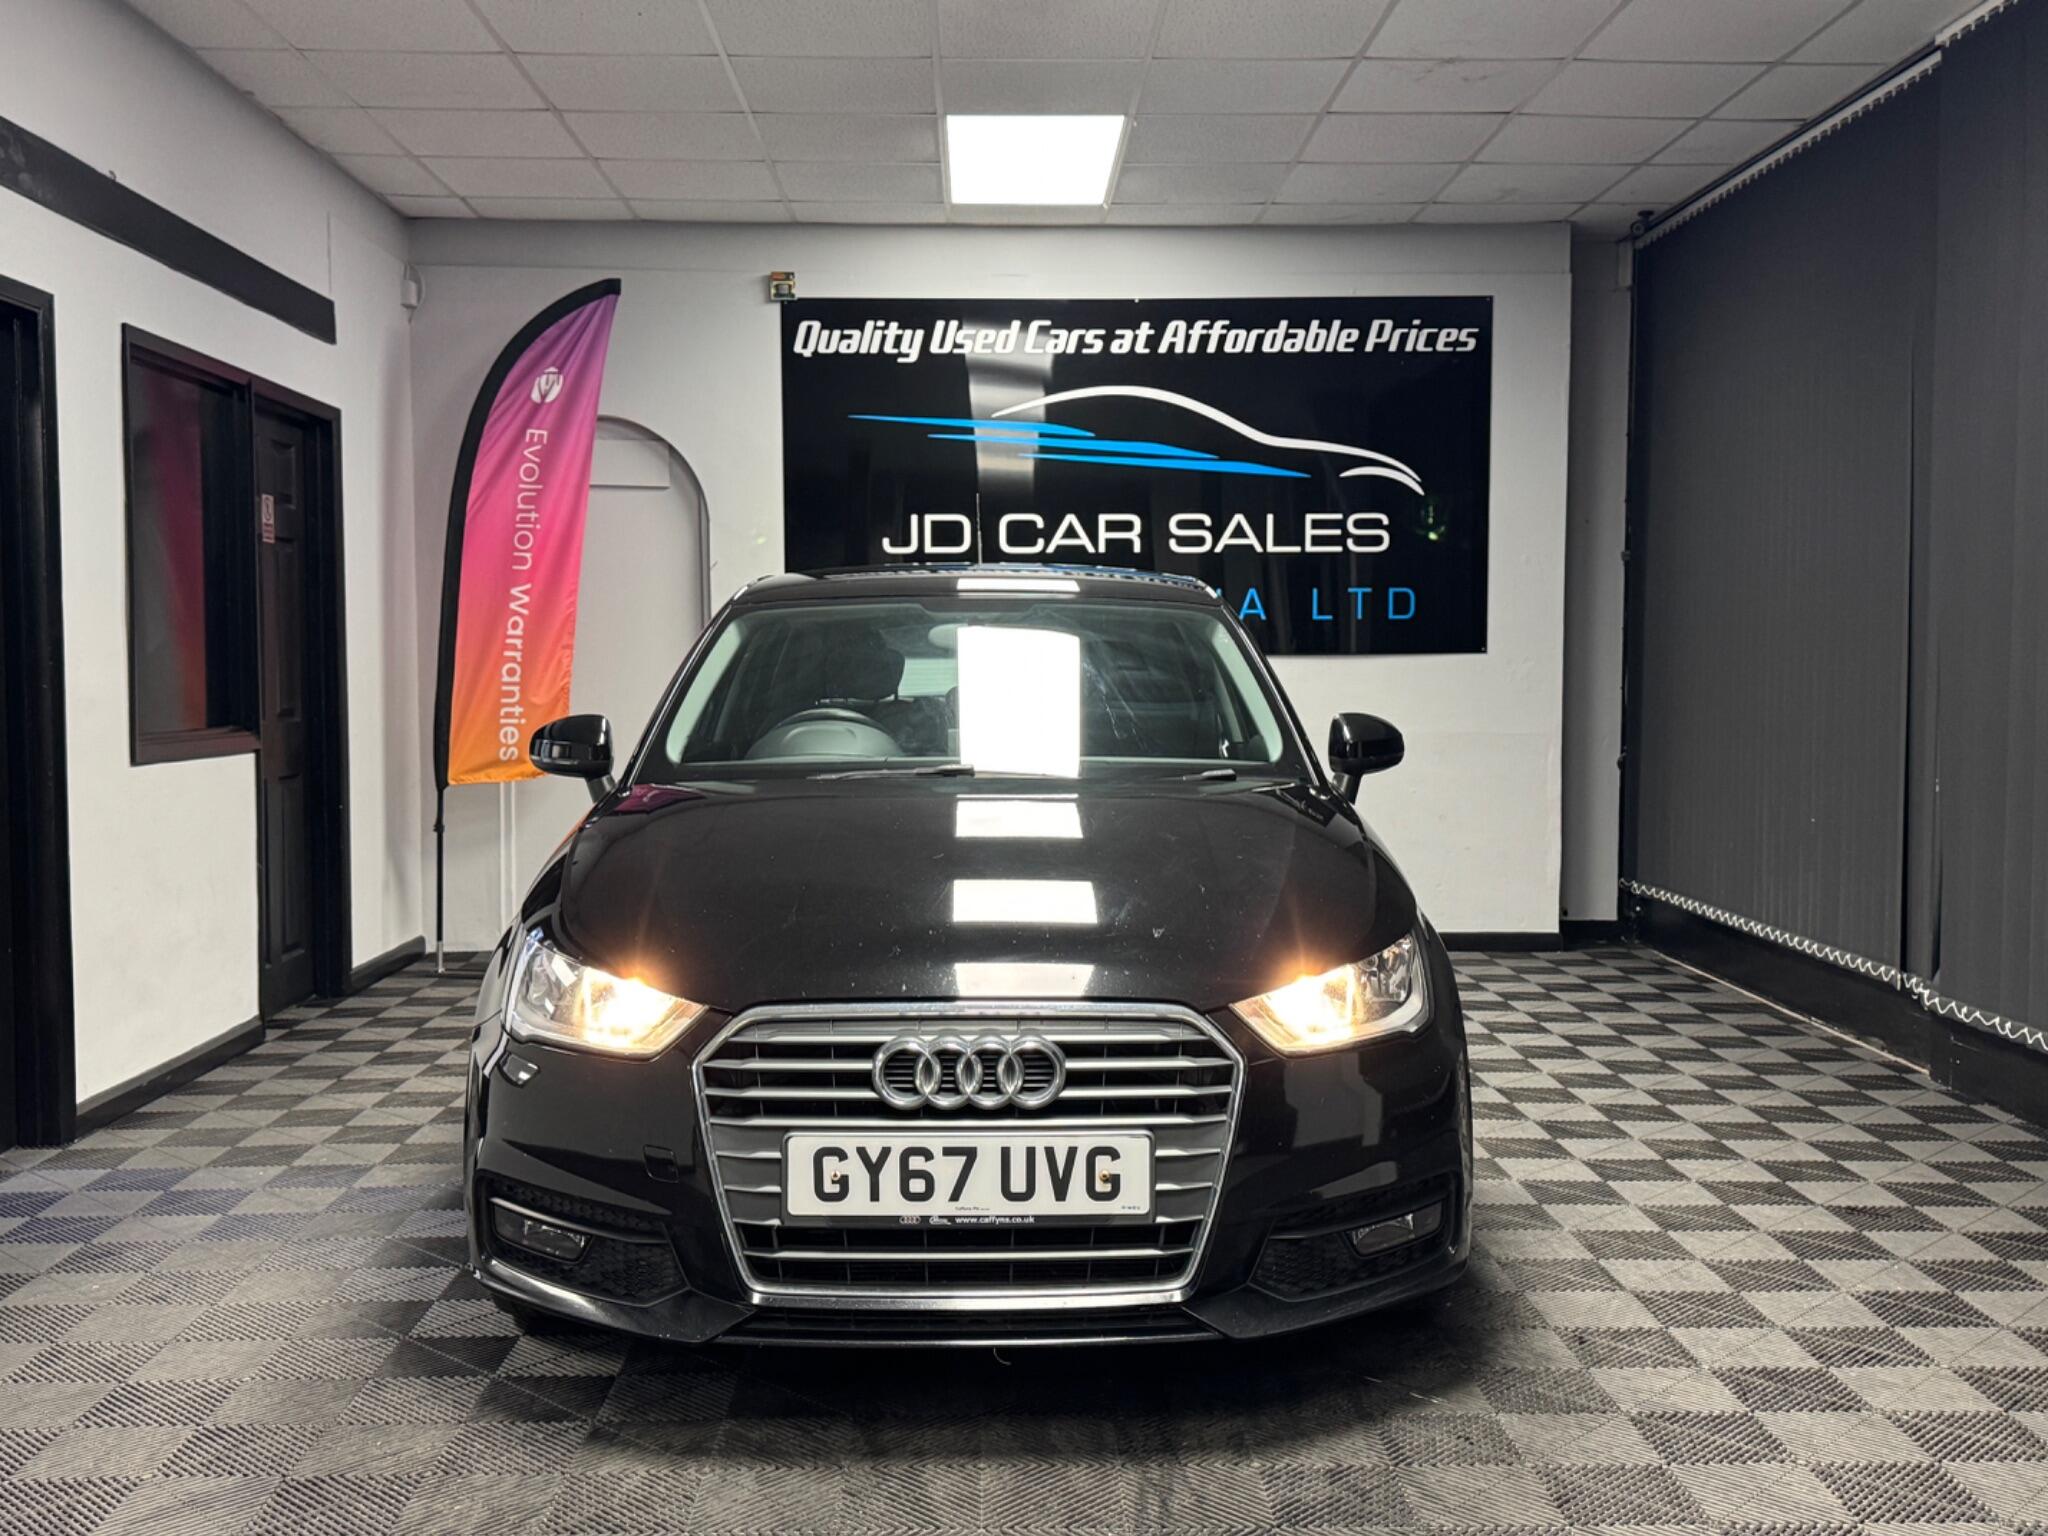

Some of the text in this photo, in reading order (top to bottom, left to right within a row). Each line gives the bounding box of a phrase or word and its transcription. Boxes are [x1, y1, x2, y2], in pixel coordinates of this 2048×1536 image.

[794, 319, 1479, 363] Quality Used Cars at Affordable Prices
[882, 512, 1391, 554] JD CAR SALES
[498, 429, 548, 762] Evolution Warranties
[1311, 586, 1416, 621] LTD
[812, 1146, 1121, 1203] GY67 UVG
